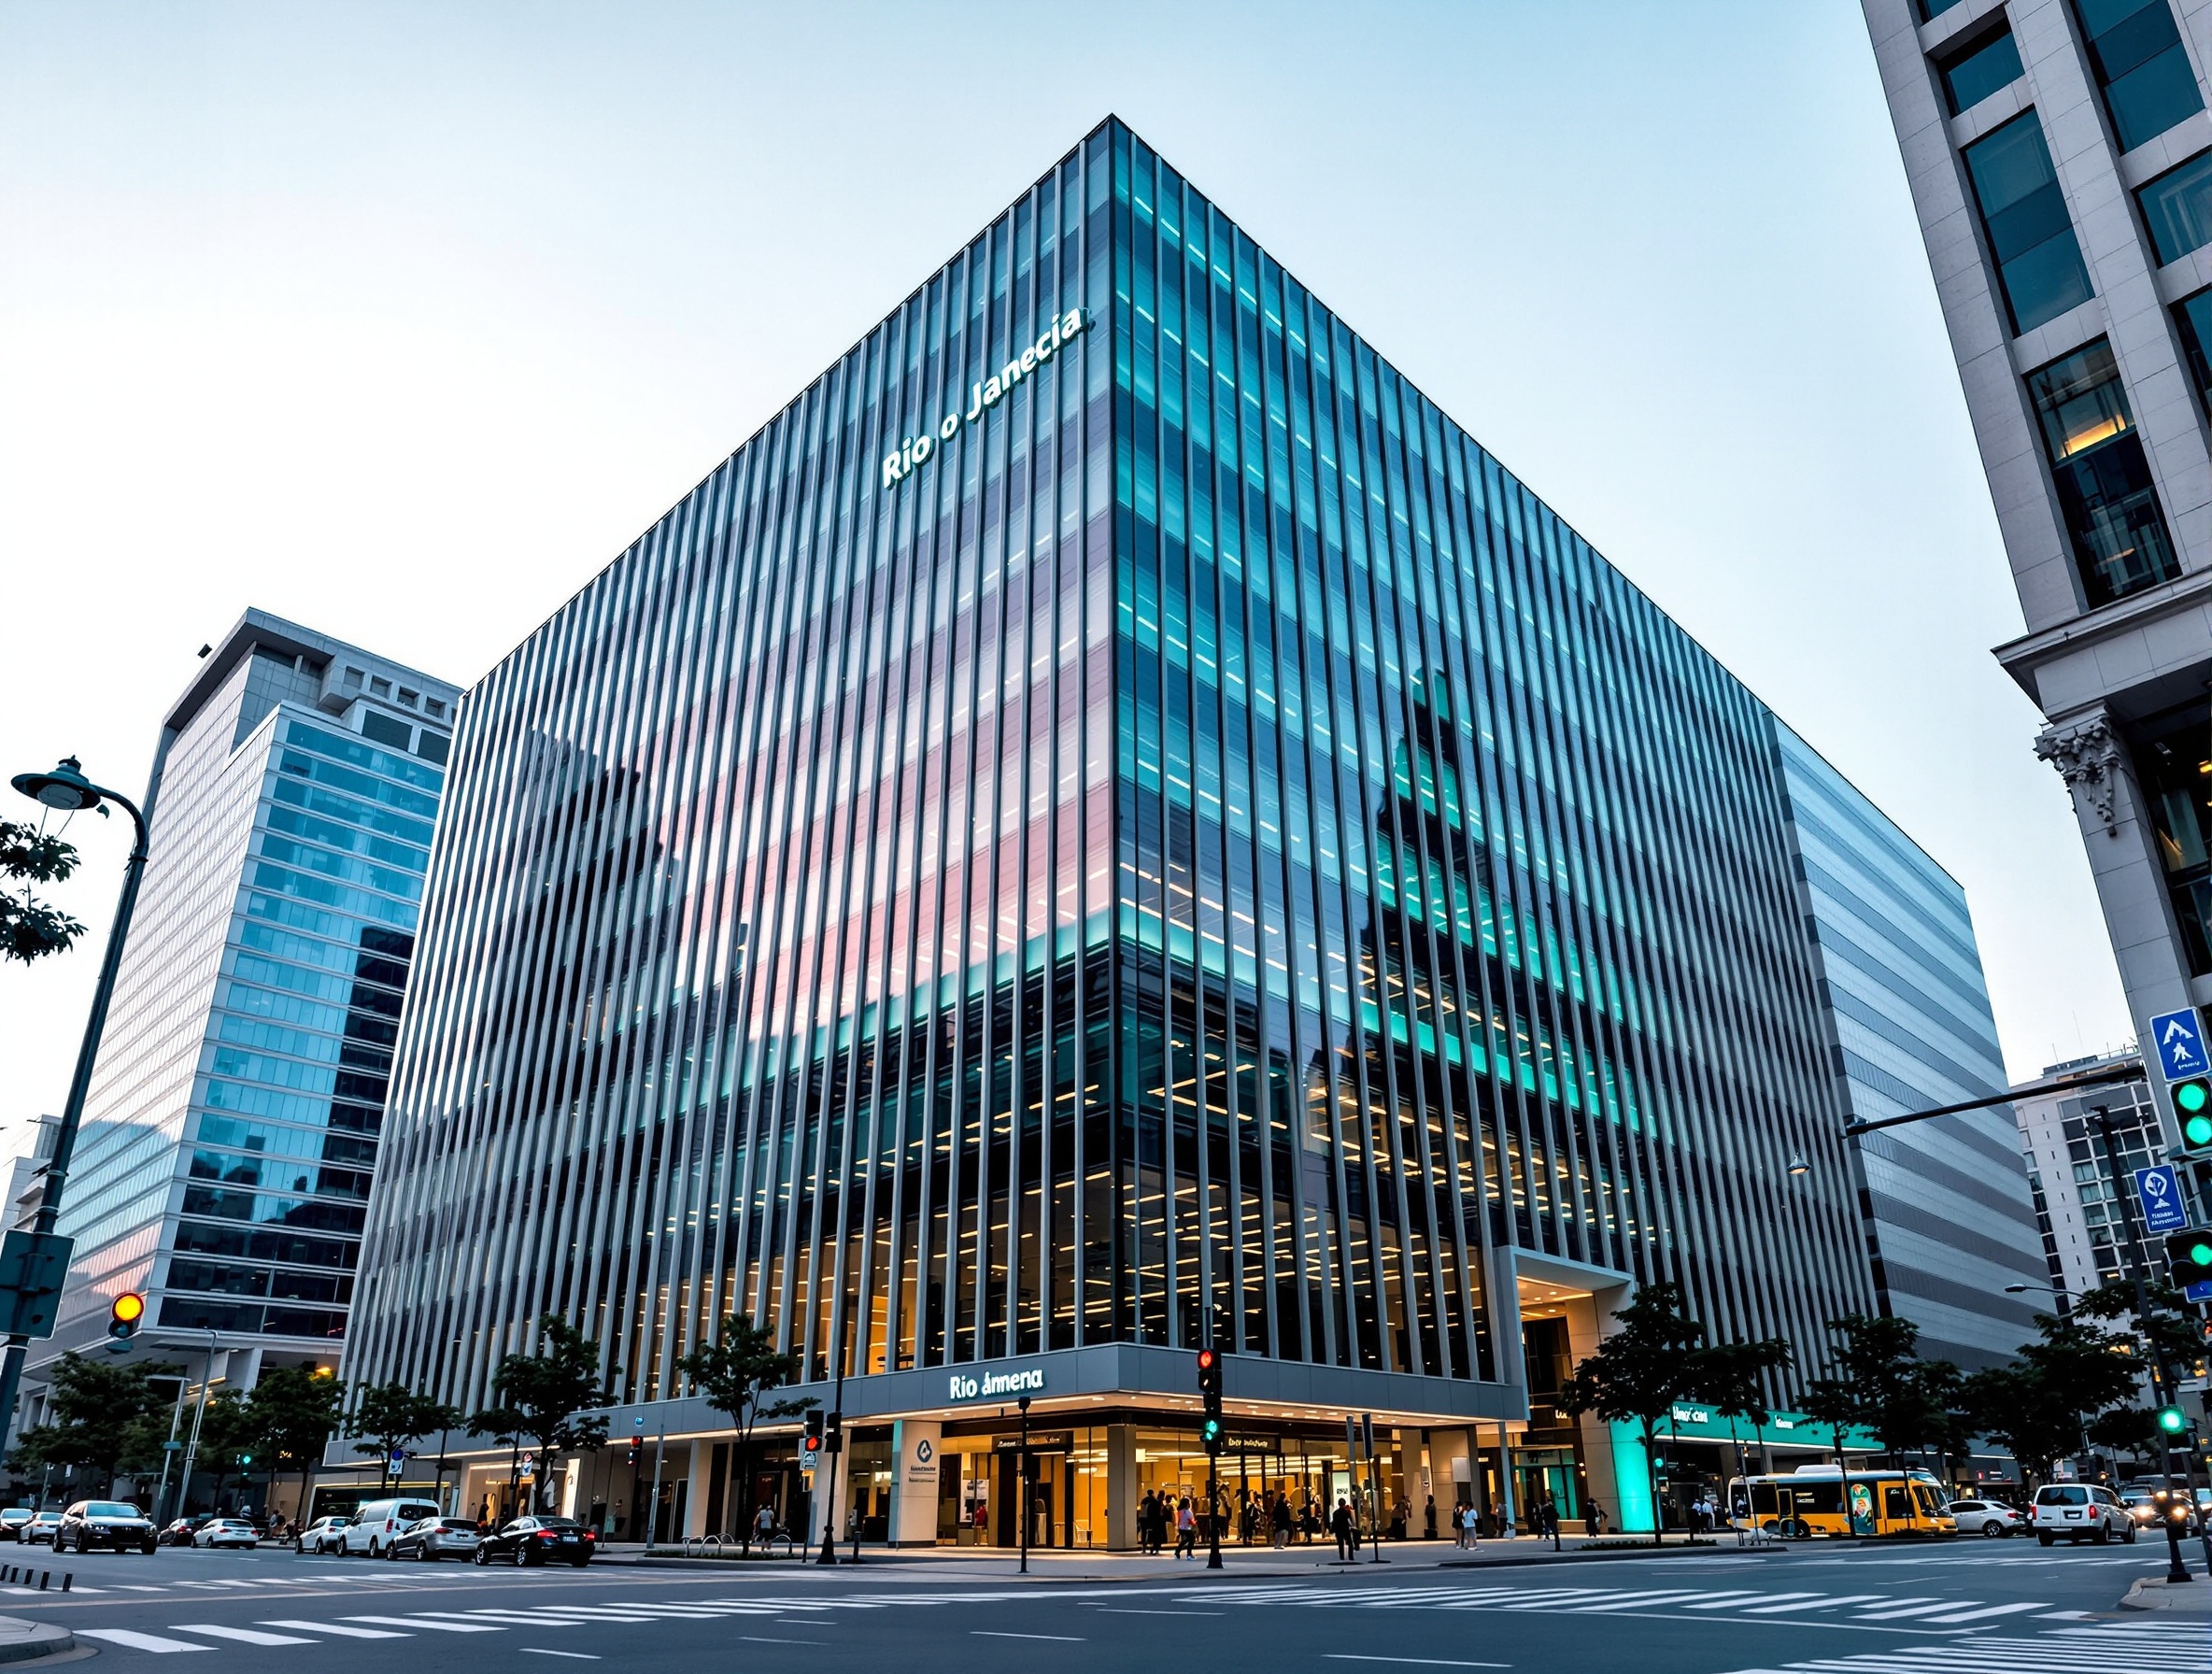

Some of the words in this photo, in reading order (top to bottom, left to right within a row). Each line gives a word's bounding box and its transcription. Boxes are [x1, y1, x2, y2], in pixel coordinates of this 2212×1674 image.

[883, 434, 932, 489] Rio
[941, 413, 959, 440] o
[966, 307, 1084, 422] Janecia
[949, 1375, 978, 1399] Rio
